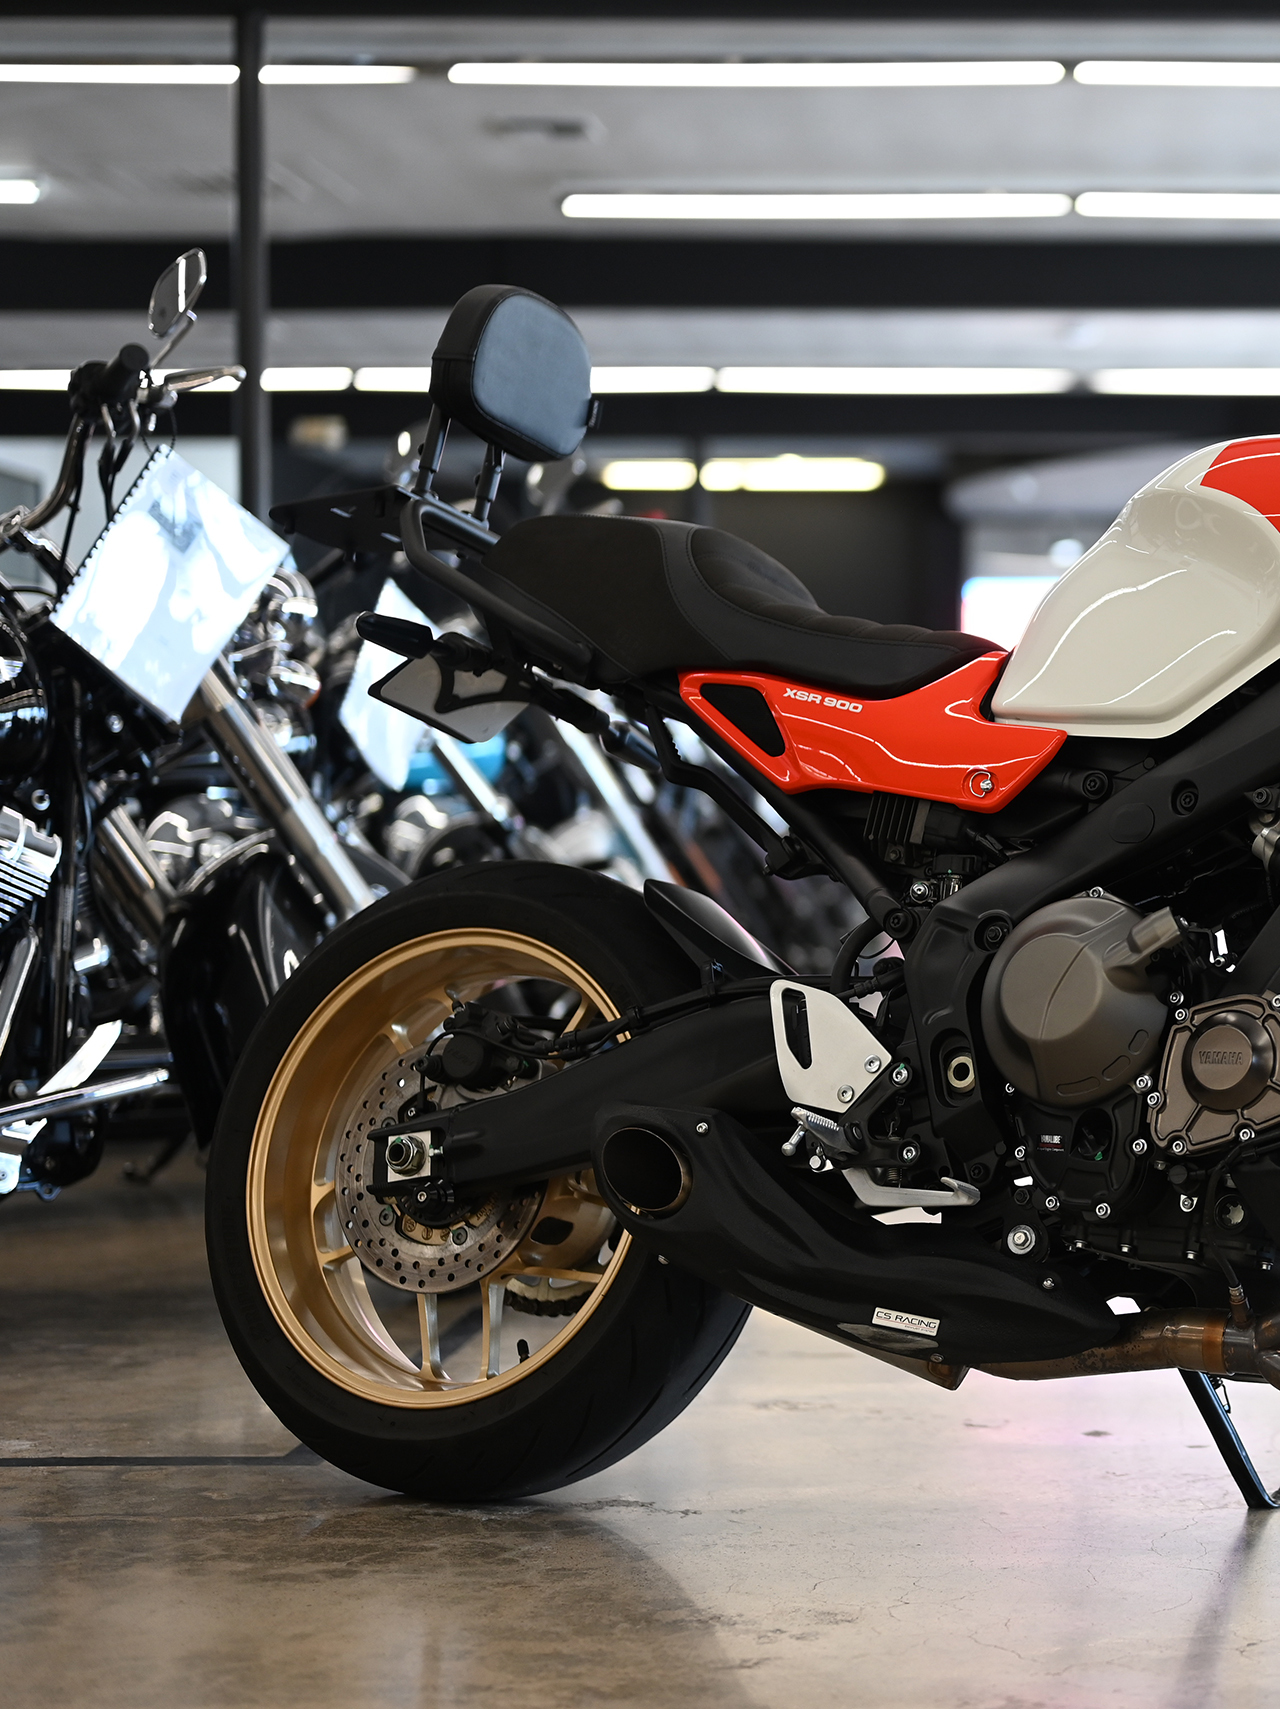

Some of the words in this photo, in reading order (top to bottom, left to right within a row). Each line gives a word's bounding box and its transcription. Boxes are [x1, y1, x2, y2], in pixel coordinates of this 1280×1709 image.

[783, 688, 822, 704] XSR
[823, 697, 863, 713] 900
[1199, 1051, 1244, 1065] YAMAHA
[876, 1311, 892, 1320] CS
[895, 1314, 937, 1329] RACING
